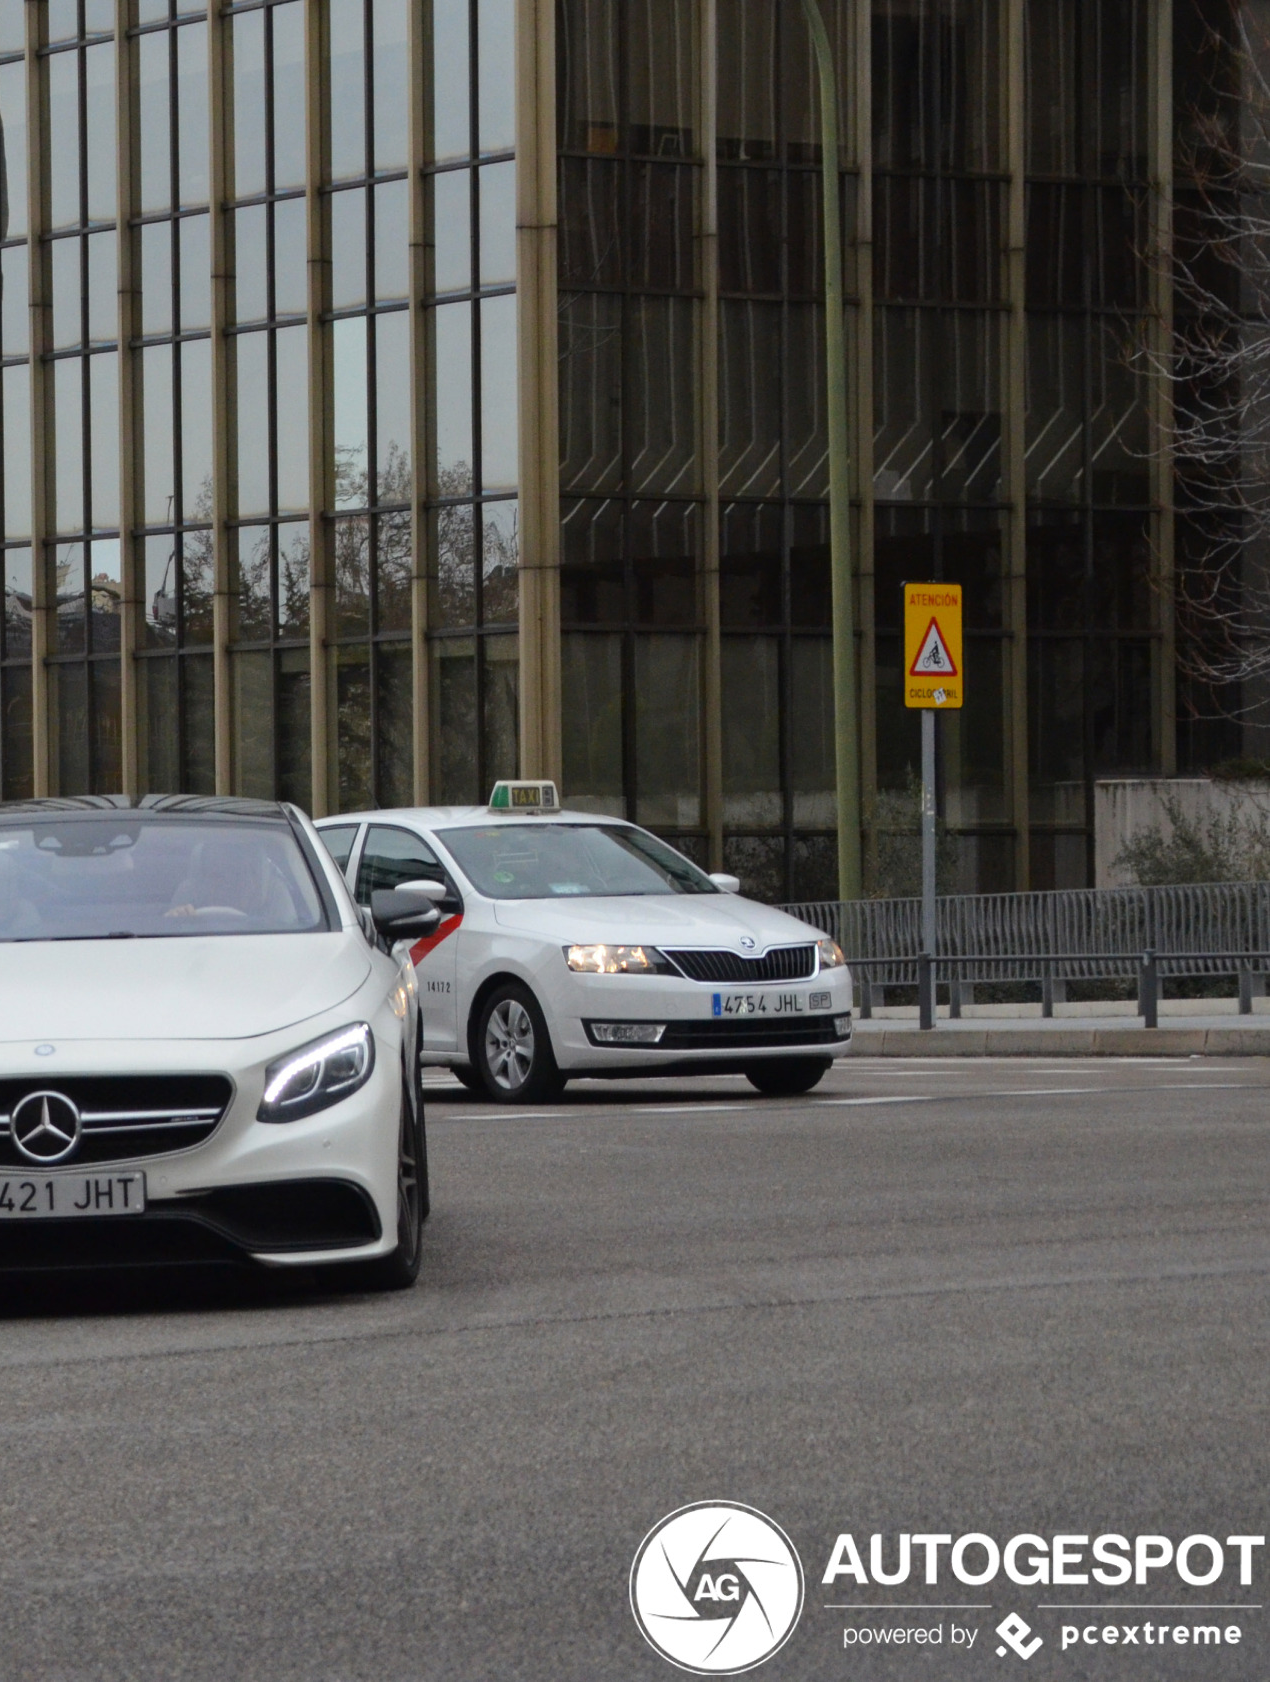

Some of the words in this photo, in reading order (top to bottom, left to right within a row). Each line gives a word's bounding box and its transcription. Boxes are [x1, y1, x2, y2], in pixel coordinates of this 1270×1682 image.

[910, 592, 958, 606] ATENCIÓN
[513, 789, 539, 805] TAXI
[427, 981, 451, 993] 14172
[724, 995, 767, 1013] 4754
[774, 994, 803, 1012] JHL
[812, 994, 828, 1007] SP
[74, 1178, 134, 1210] JHT
